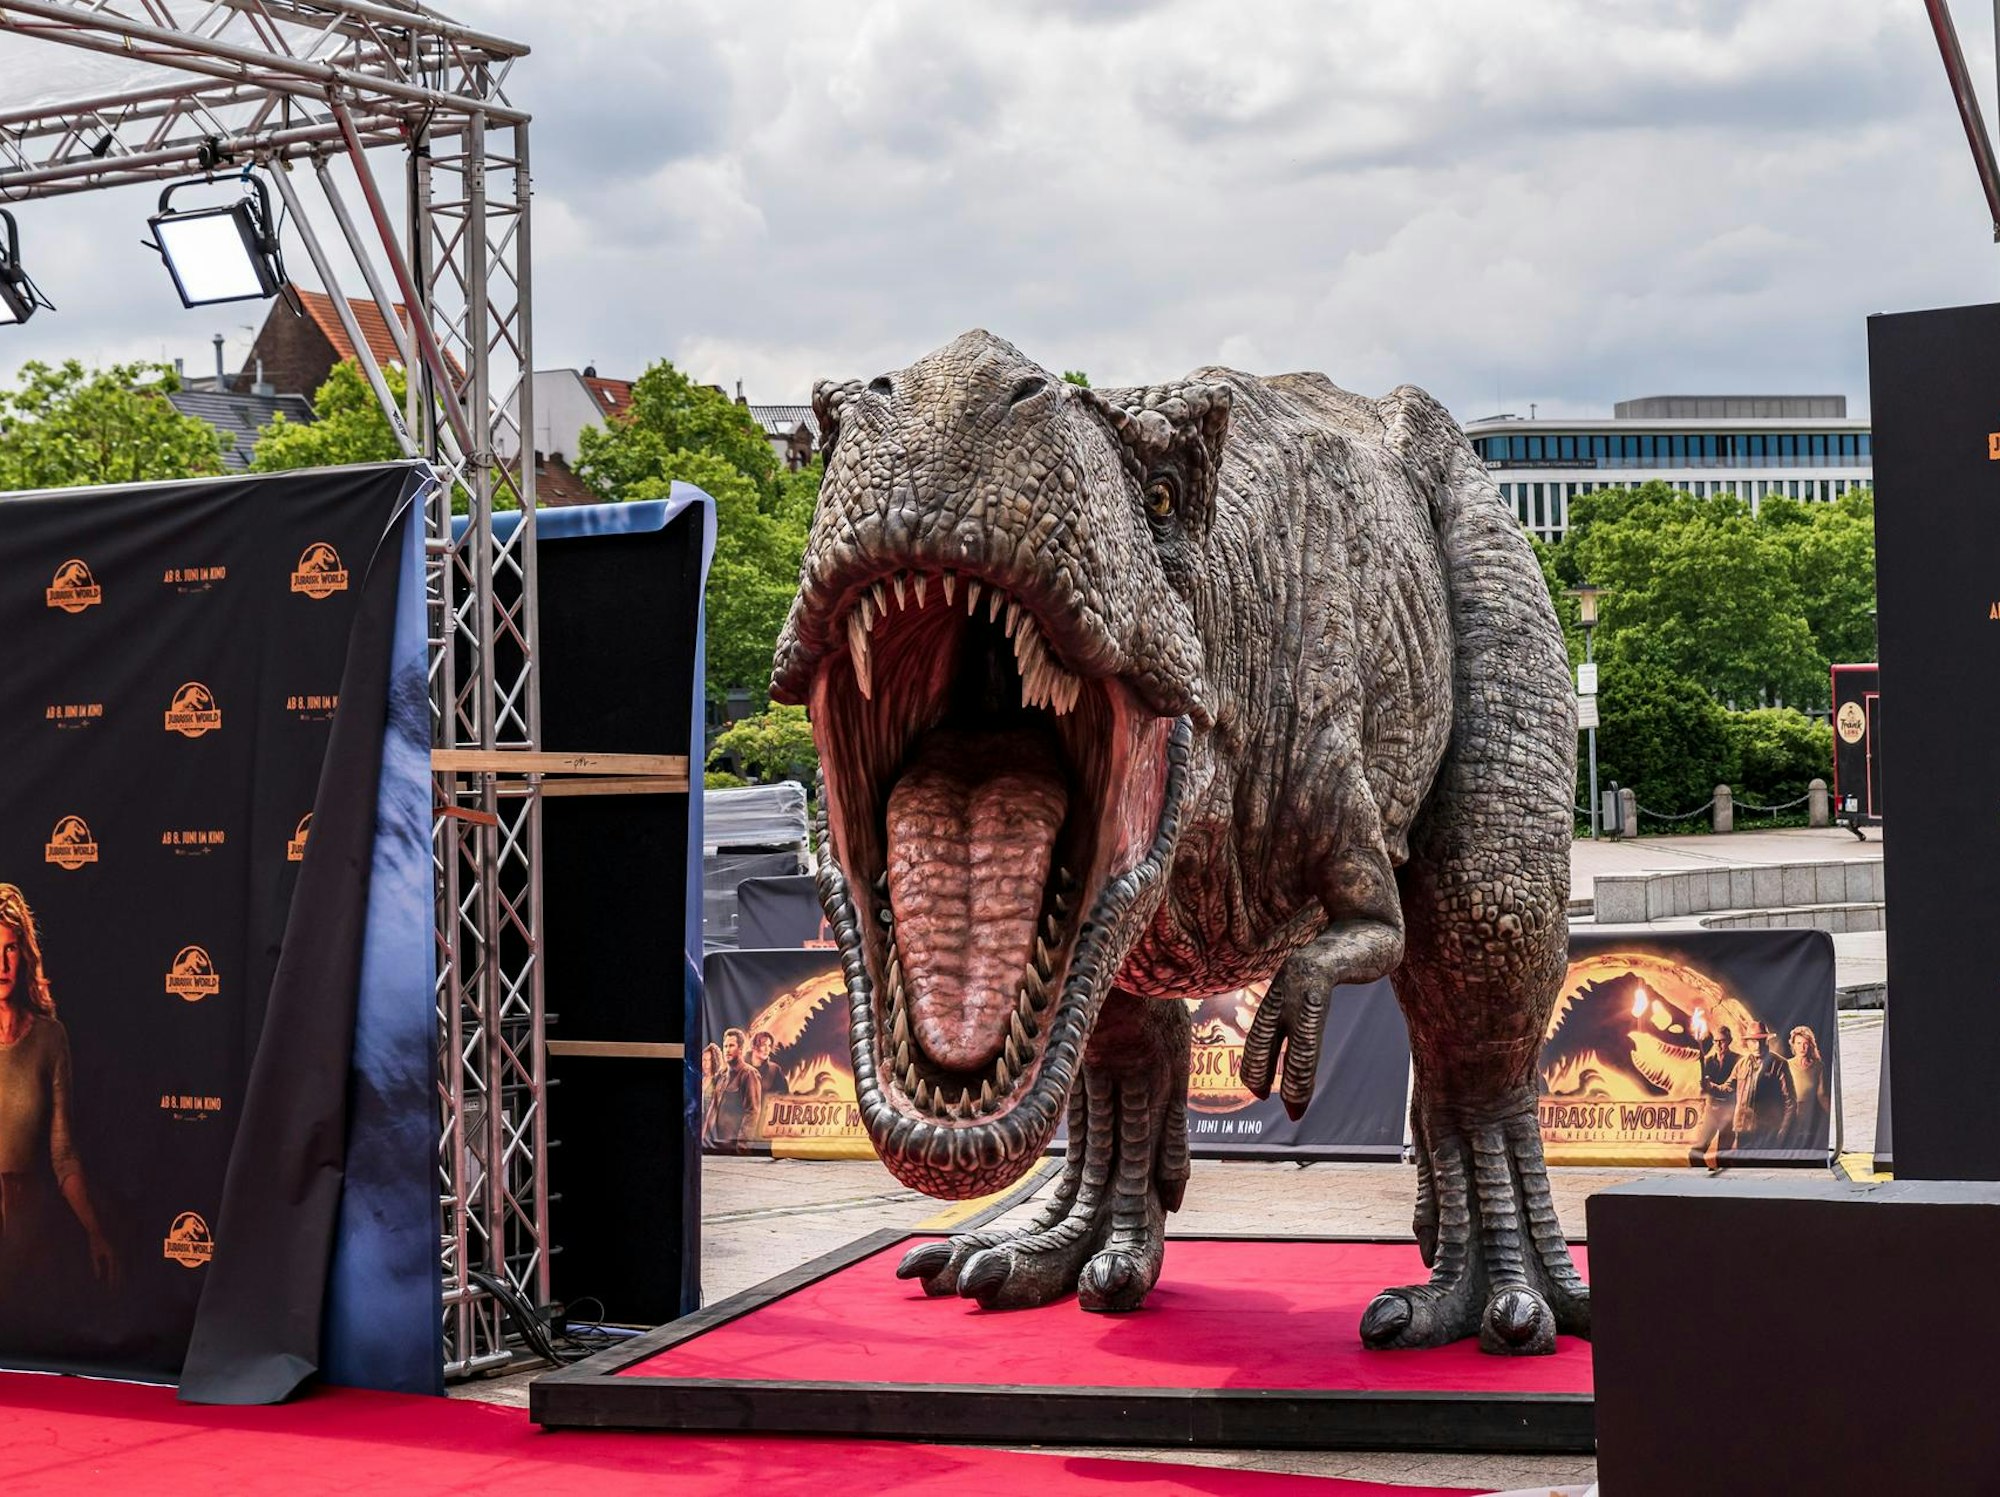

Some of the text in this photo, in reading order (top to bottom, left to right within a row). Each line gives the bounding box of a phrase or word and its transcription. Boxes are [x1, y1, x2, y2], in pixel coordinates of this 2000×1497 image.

[163, 569, 173, 583] AB
[184, 568, 199, 582] JUNI
[200, 567, 209, 581] IM
[210, 566, 226, 580] KINO
[321, 572, 346, 584] WORLD
[287, 696, 297, 710] AB
[307, 695, 321, 710] JUNI
[321, 695, 331, 709] IM
[46, 705, 56, 719] AB
[64, 704, 78, 718] JUNI
[79, 703, 87, 717] IM
[87, 703, 103, 717] KINO
[162, 831, 172, 845] AB
[182, 830, 198, 845] JUNI
[198, 830, 208, 844] IM
[208, 830, 225, 844] KINO
[160, 1095, 170, 1109] AB
[180, 1096, 194, 1109] JUNI
[194, 1097, 203, 1110] IM
[204, 1097, 221, 1111] KINO
[768, 1103, 842, 1126] JURASSIC
[1540, 1105, 1698, 1131] URASSIC WORLD
[1196, 1120, 1218, 1133] JUNI
[1221, 1120, 1233, 1134] IM
[1237, 1121, 1263, 1134] KINO
